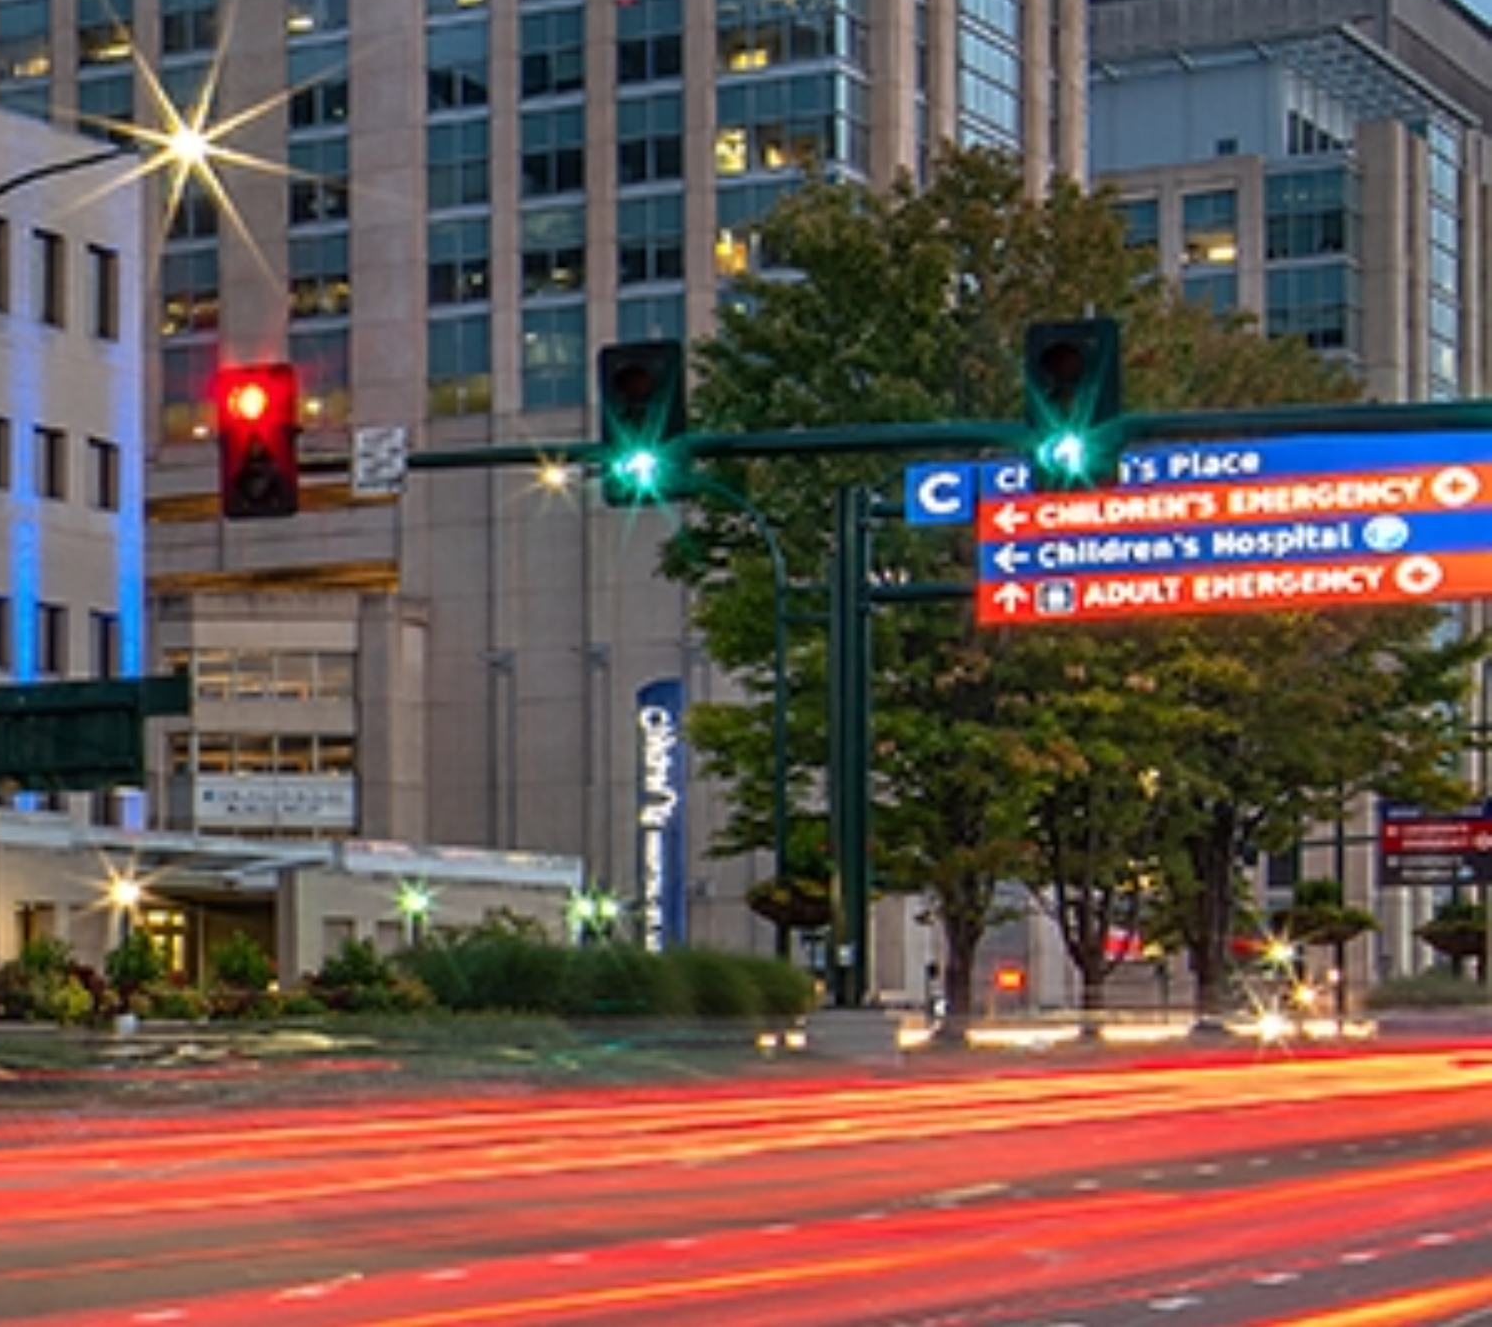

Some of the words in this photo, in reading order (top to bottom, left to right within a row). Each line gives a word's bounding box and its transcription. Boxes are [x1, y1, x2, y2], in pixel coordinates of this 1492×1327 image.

[1168, 450, 1260, 478] Place
[918, 472, 962, 514] C
[1036, 492, 1218, 529] CHILDREN'S
[1228, 476, 1422, 515] EMERGENCY
[1037, 532, 1200, 568] Children's
[1212, 521, 1351, 557] Hospital
[1084, 576, 1182, 608] ADULT
[1192, 565, 1384, 603] EMERGENCY
